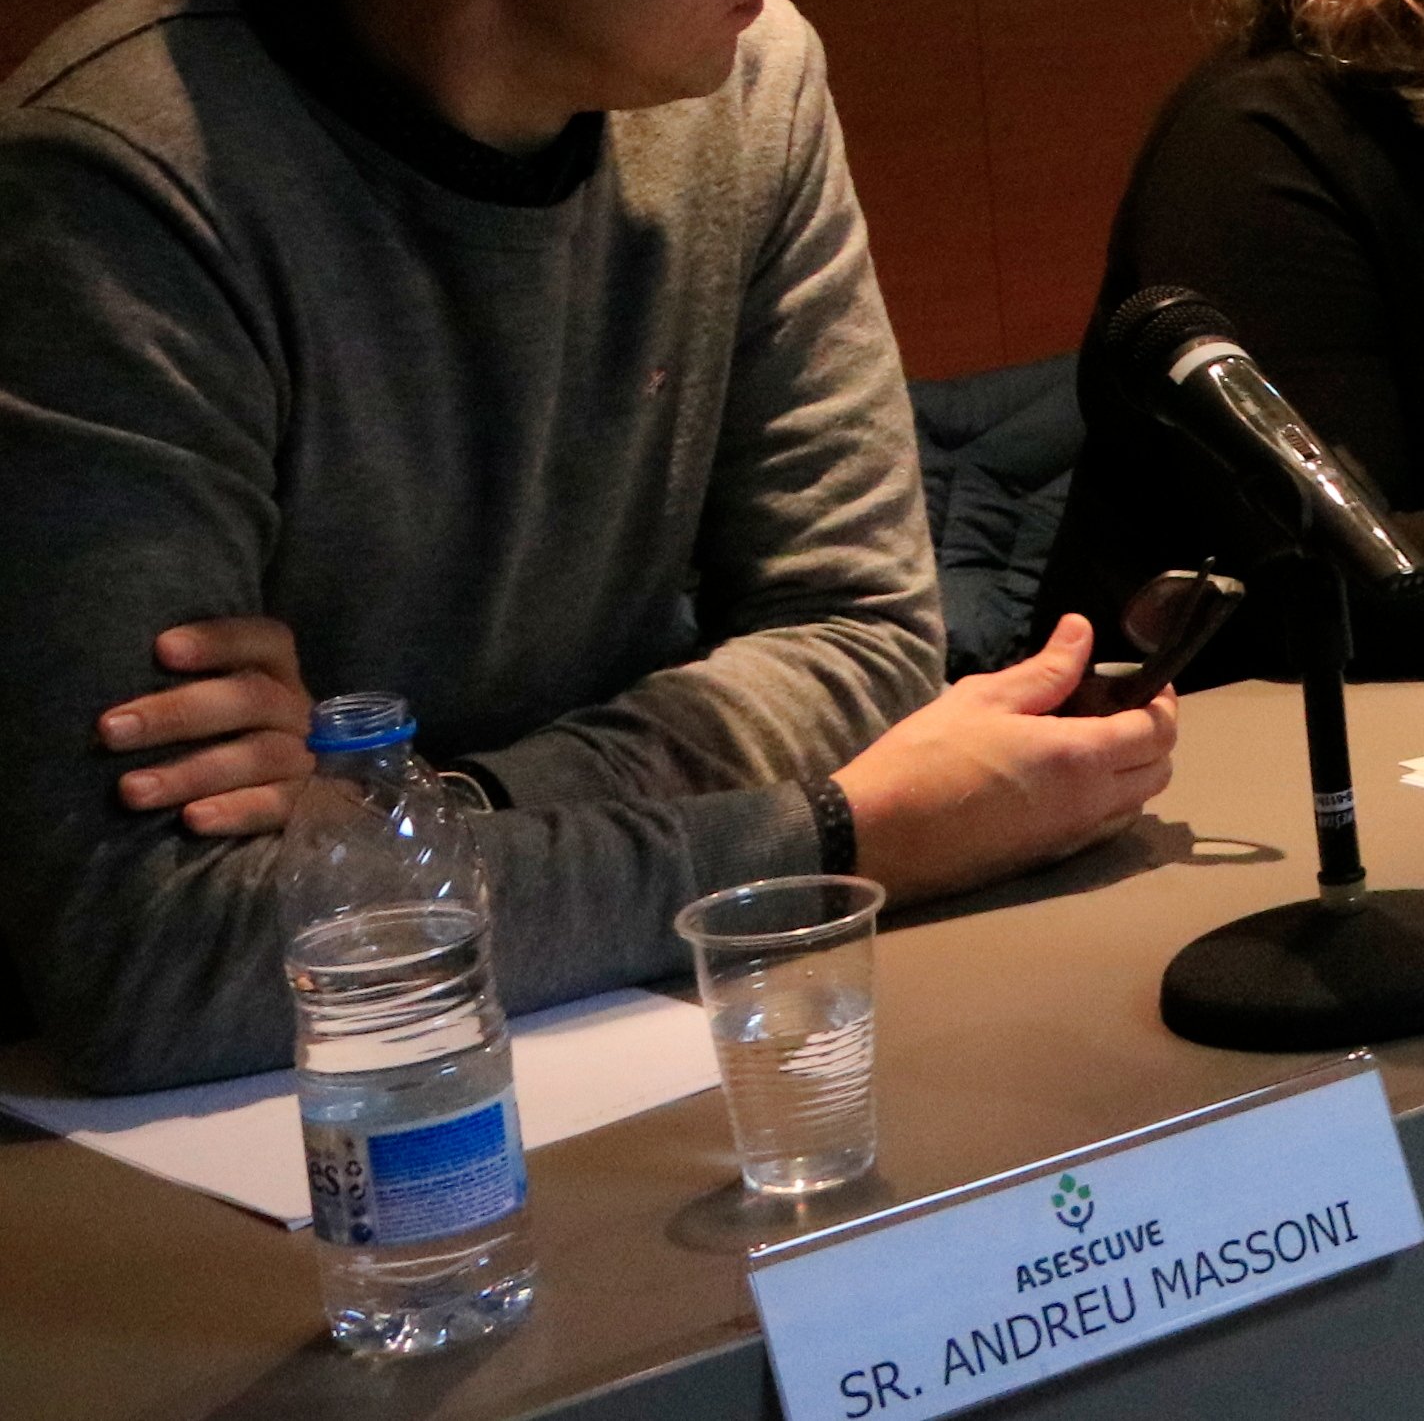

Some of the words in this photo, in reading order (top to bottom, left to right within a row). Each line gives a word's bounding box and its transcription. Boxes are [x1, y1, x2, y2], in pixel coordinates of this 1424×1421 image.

[839, 1359, 924, 1419] SR.
[942, 1277, 1137, 1385] ANDREU
[1151, 1201, 1360, 1309] MASSONI
[1015, 1219, 1165, 1293] ASESCUVE
